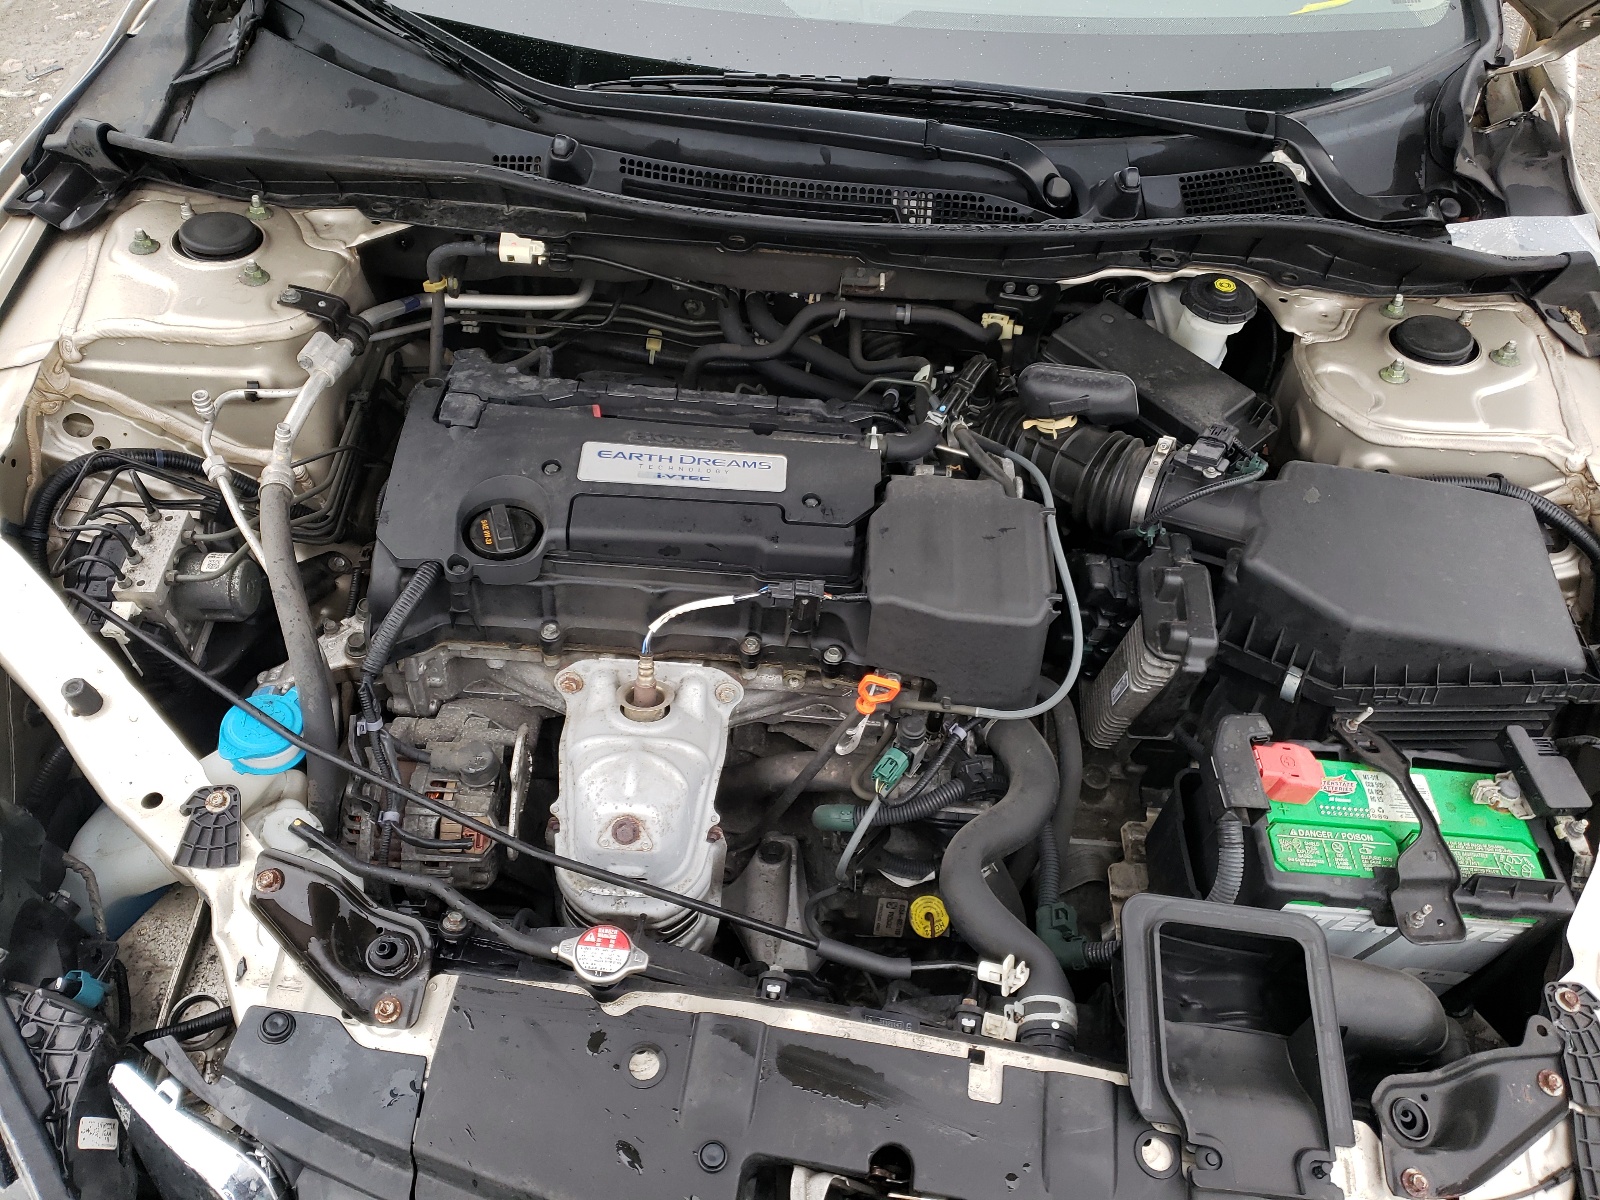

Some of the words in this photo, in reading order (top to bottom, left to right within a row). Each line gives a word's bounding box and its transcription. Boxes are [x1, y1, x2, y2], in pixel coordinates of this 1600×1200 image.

[597, 450, 673, 463] EARTH
[679, 454, 772, 470] DREAMS
[638, 463, 730, 475] TECHNOLOGY
[656, 472, 711, 482] i-VTEC
[1298, 829, 1334, 839] DANGER
[1341, 832, 1374, 842] POISON
